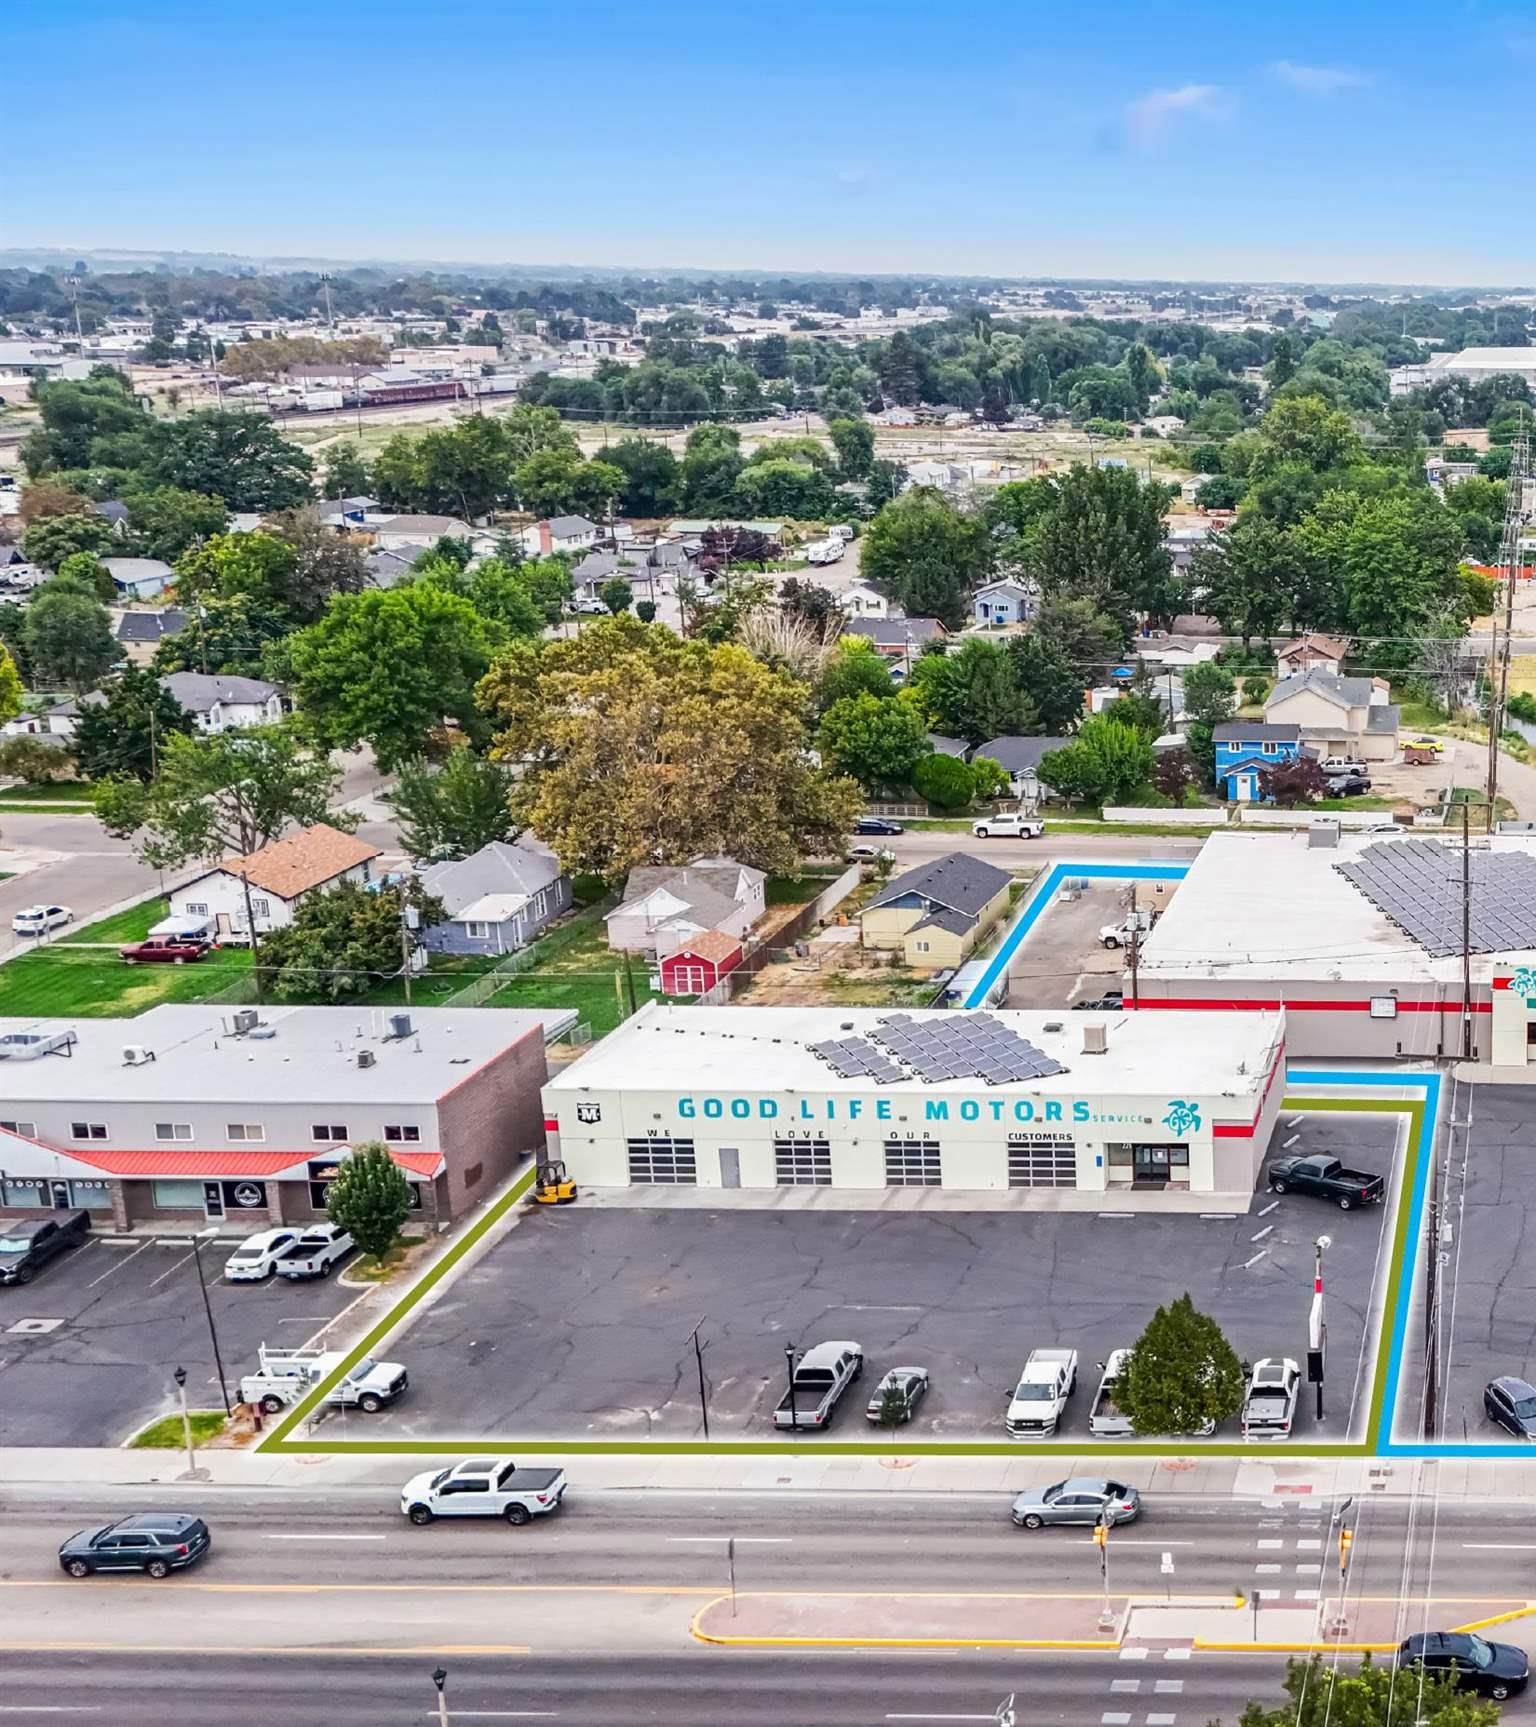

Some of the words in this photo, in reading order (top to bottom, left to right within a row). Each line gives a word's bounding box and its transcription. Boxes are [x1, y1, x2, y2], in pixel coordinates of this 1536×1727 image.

[677, 1098, 778, 1119] GOOD
[800, 1099, 892, 1120] LIFE
[925, 1100, 1090, 1122] MOTORS
[647, 1129, 671, 1137] WE
[774, 1130, 825, 1139] LOVE
[890, 1131, 931, 1140] OUR
[1008, 1132, 1073, 1141] CUSTOMERS
